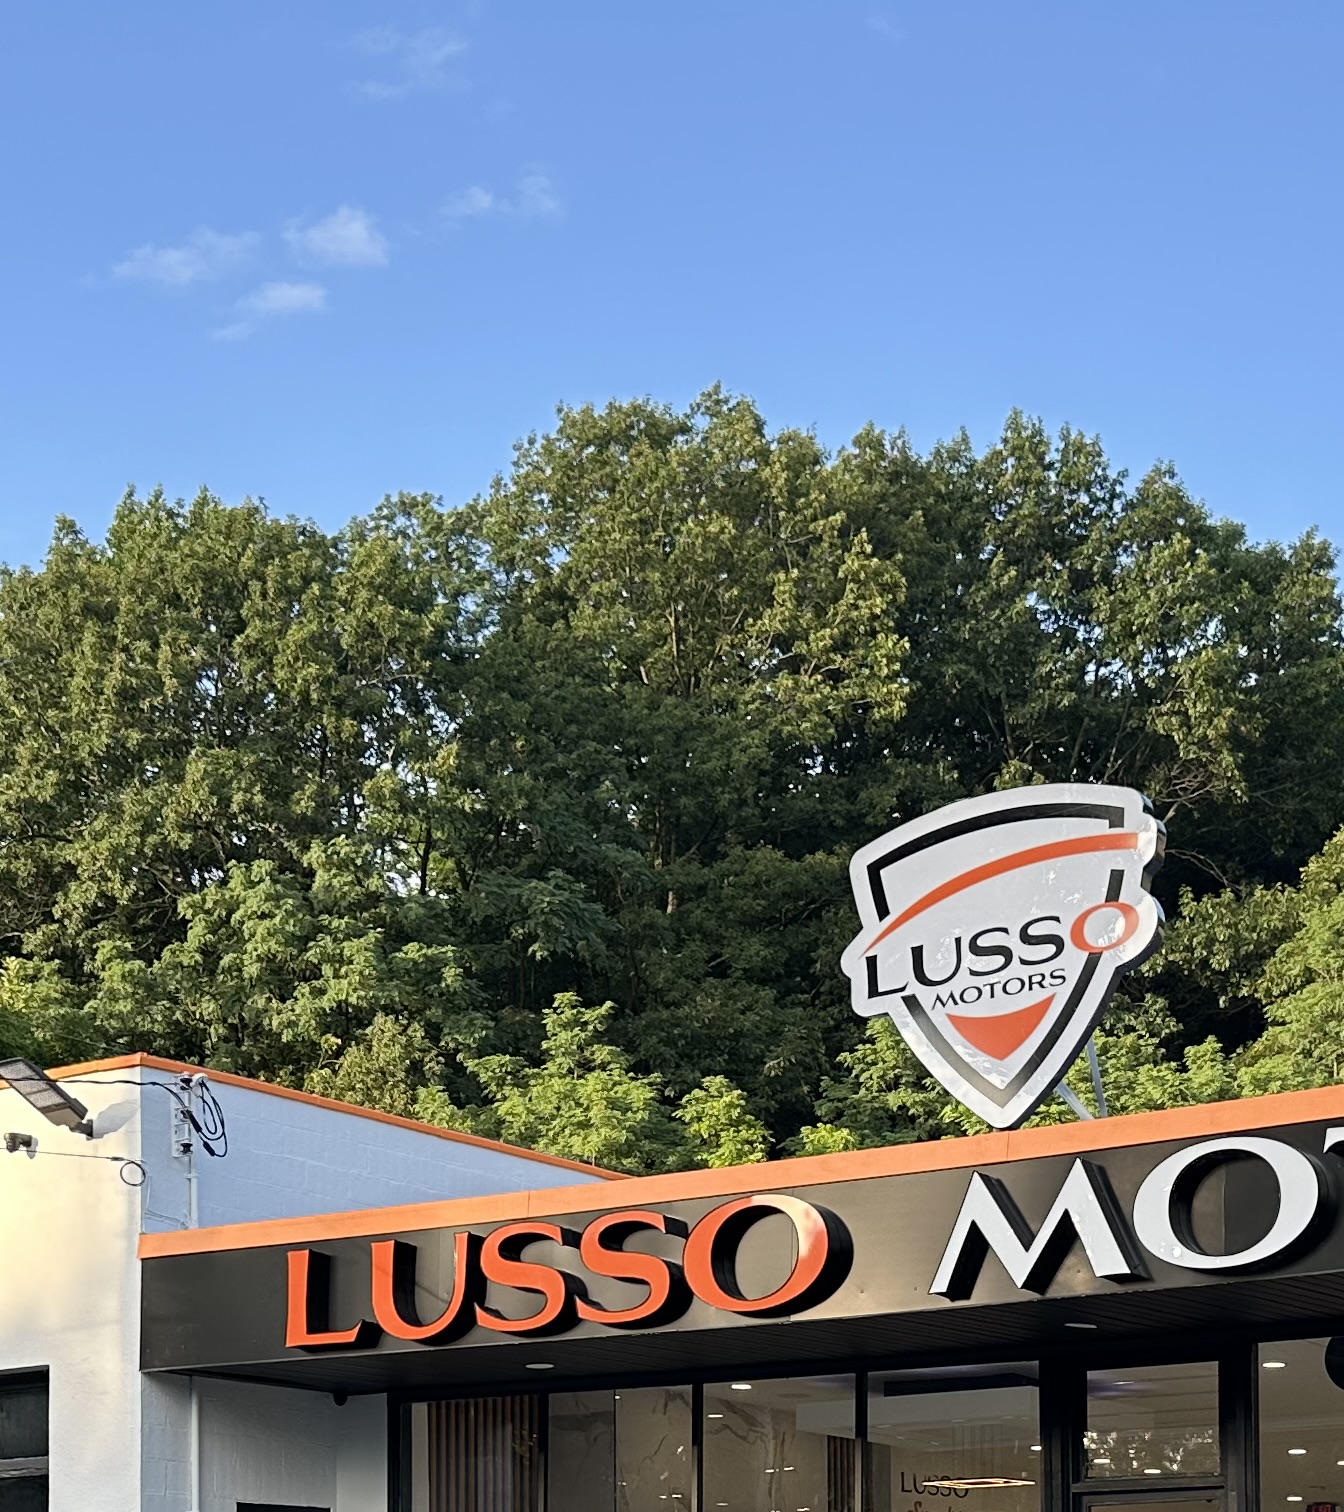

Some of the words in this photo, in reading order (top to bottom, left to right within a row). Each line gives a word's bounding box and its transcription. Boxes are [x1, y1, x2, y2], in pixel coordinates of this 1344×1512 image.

[866, 901, 1140, 1000] LUSSO
[931, 968, 1066, 1011] MOTORS
[285, 1193, 838, 1349] LUSSO
[900, 1471, 969, 1498] LUSSO
